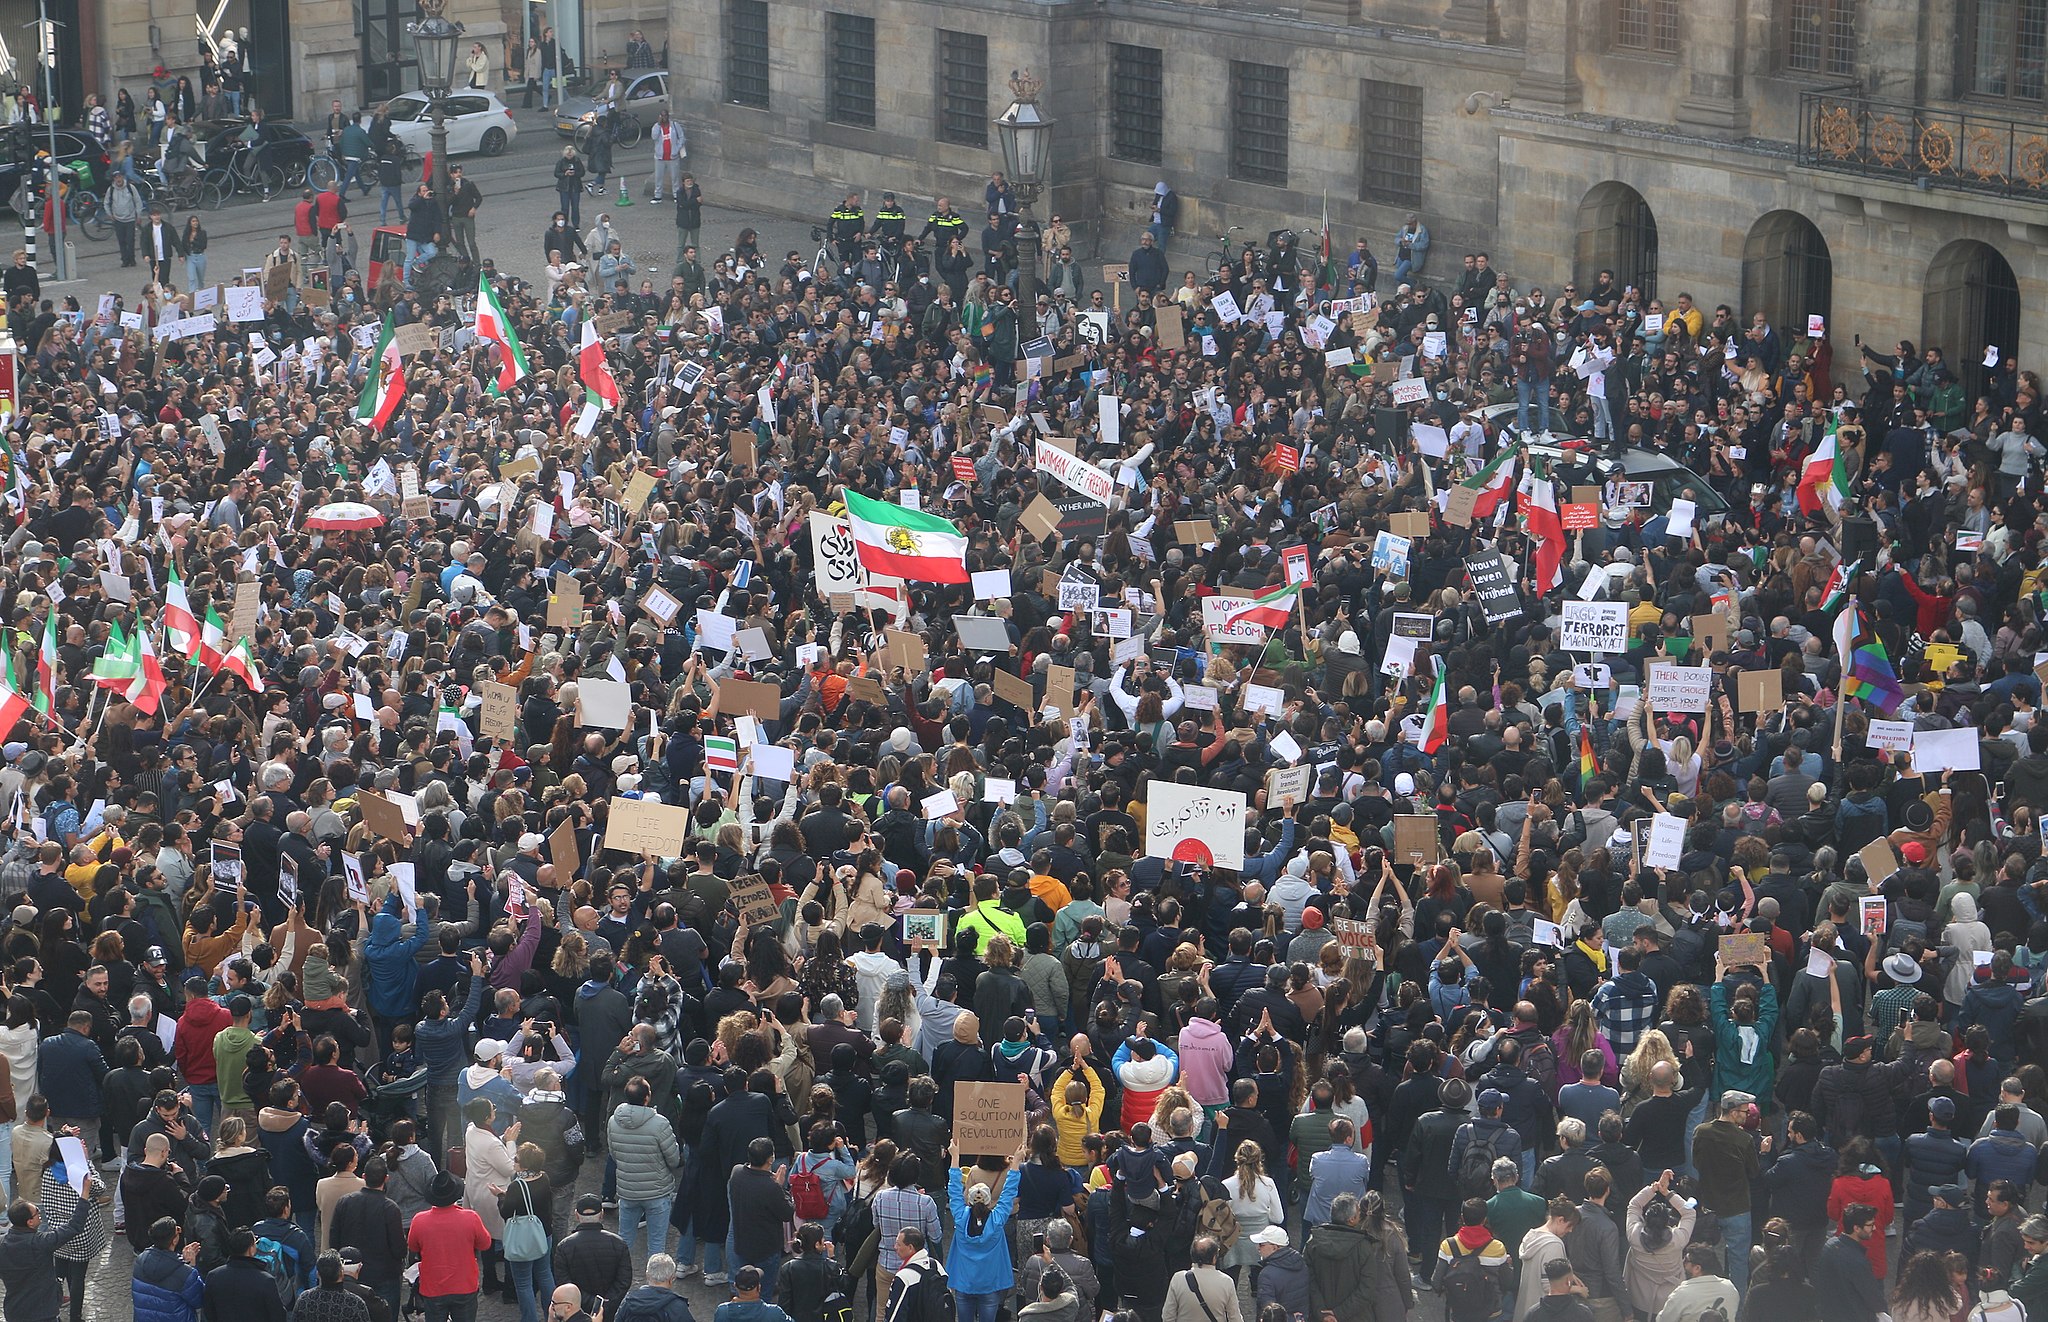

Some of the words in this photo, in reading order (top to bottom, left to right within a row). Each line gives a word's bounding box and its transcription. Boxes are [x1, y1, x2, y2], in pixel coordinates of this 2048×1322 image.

[1393, 384, 1422, 395] #Mahsa
[1400, 391, 1421, 401] Amini
[1037, 445, 1071, 478] WOMAN
[1067, 463, 1088, 487] LIFE
[1084, 472, 1113, 501] FREEDOM
[1069, 502, 1083, 511] HER
[1083, 500, 1102, 509] NAME
[1400, 539, 1410, 547] OUT
[1467, 558, 1499, 573] Vrouw
[1473, 571, 1502, 586] Leven
[1478, 584, 1515, 601] Vrijheid
[1486, 607, 1523, 623] Mahsaamini
[1564, 605, 1597, 621] IRGC
[1564, 621, 1626, 637] TERRORIST
[1655, 670, 1678, 681] THEIR
[1684, 671, 1710, 682] BODIES
[1654, 685, 1676, 693] THEIR
[1680, 687, 1707, 695] CHOICE
[486, 702, 497, 713] LIFE
[1663, 701, 1697, 709] SISTERS
[1871, 734, 1908, 742] REVOLUTION!
[1280, 770, 1301, 780] Support
[1280, 779, 1299, 788] Iranian
[1178, 797, 1211, 821] زندگی
[1216, 801, 1237, 823] زن
[635, 817, 661, 832] LIFE
[1659, 821, 1680, 832] Woman
[622, 832, 682, 853] FREEDOM
[1652, 850, 1678, 860] Freedom
[1337, 920, 1350, 932] BE
[1352, 921, 1373, 934] THE
[1339, 931, 1374, 948] VOICE
[1341, 945, 1353, 959] OF
[1358, 947, 1376, 961] IRA
[977, 1098, 1000, 1110] ONE
[960, 1110, 1021, 1122] SOLUTION!
[960, 1126, 1024, 1140] REVOLUTION!
